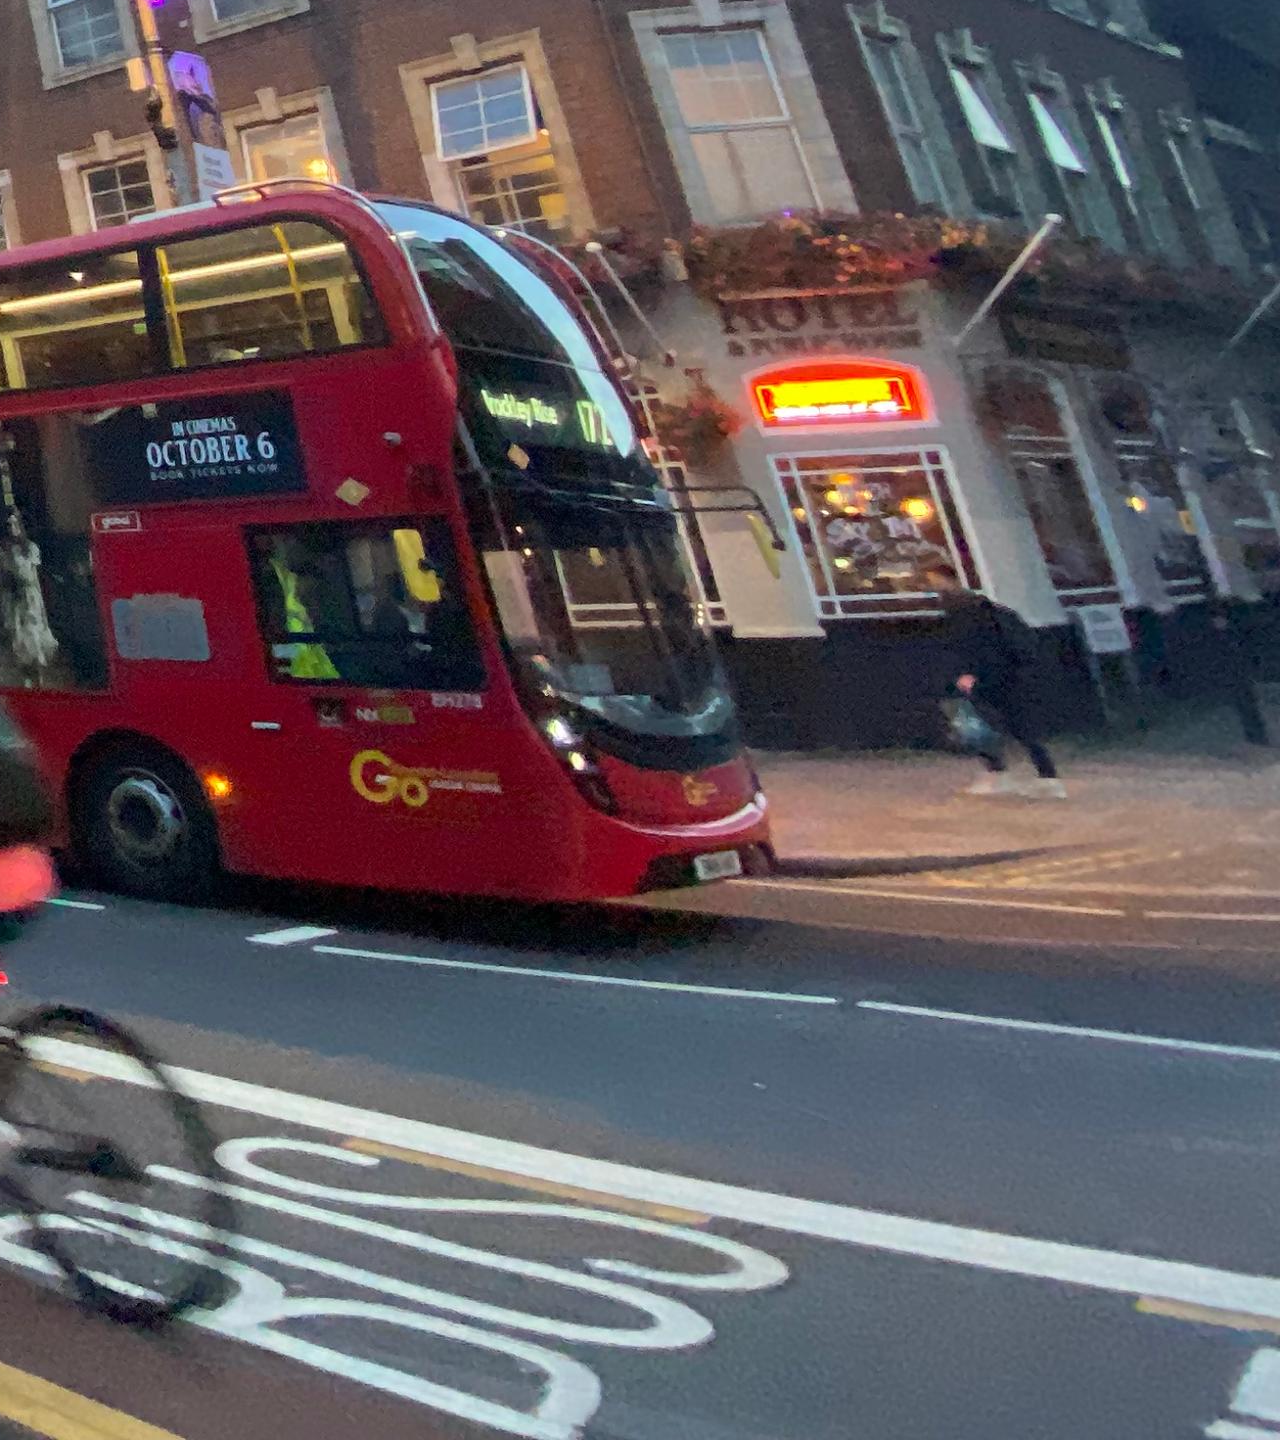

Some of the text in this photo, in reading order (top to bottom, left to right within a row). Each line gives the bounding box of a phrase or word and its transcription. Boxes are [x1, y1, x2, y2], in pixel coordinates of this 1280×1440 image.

[171, 416, 237, 437] IN CINEMAS
[146, 431, 275, 468] OCTOBER 6
[349, 749, 429, 808] Go
